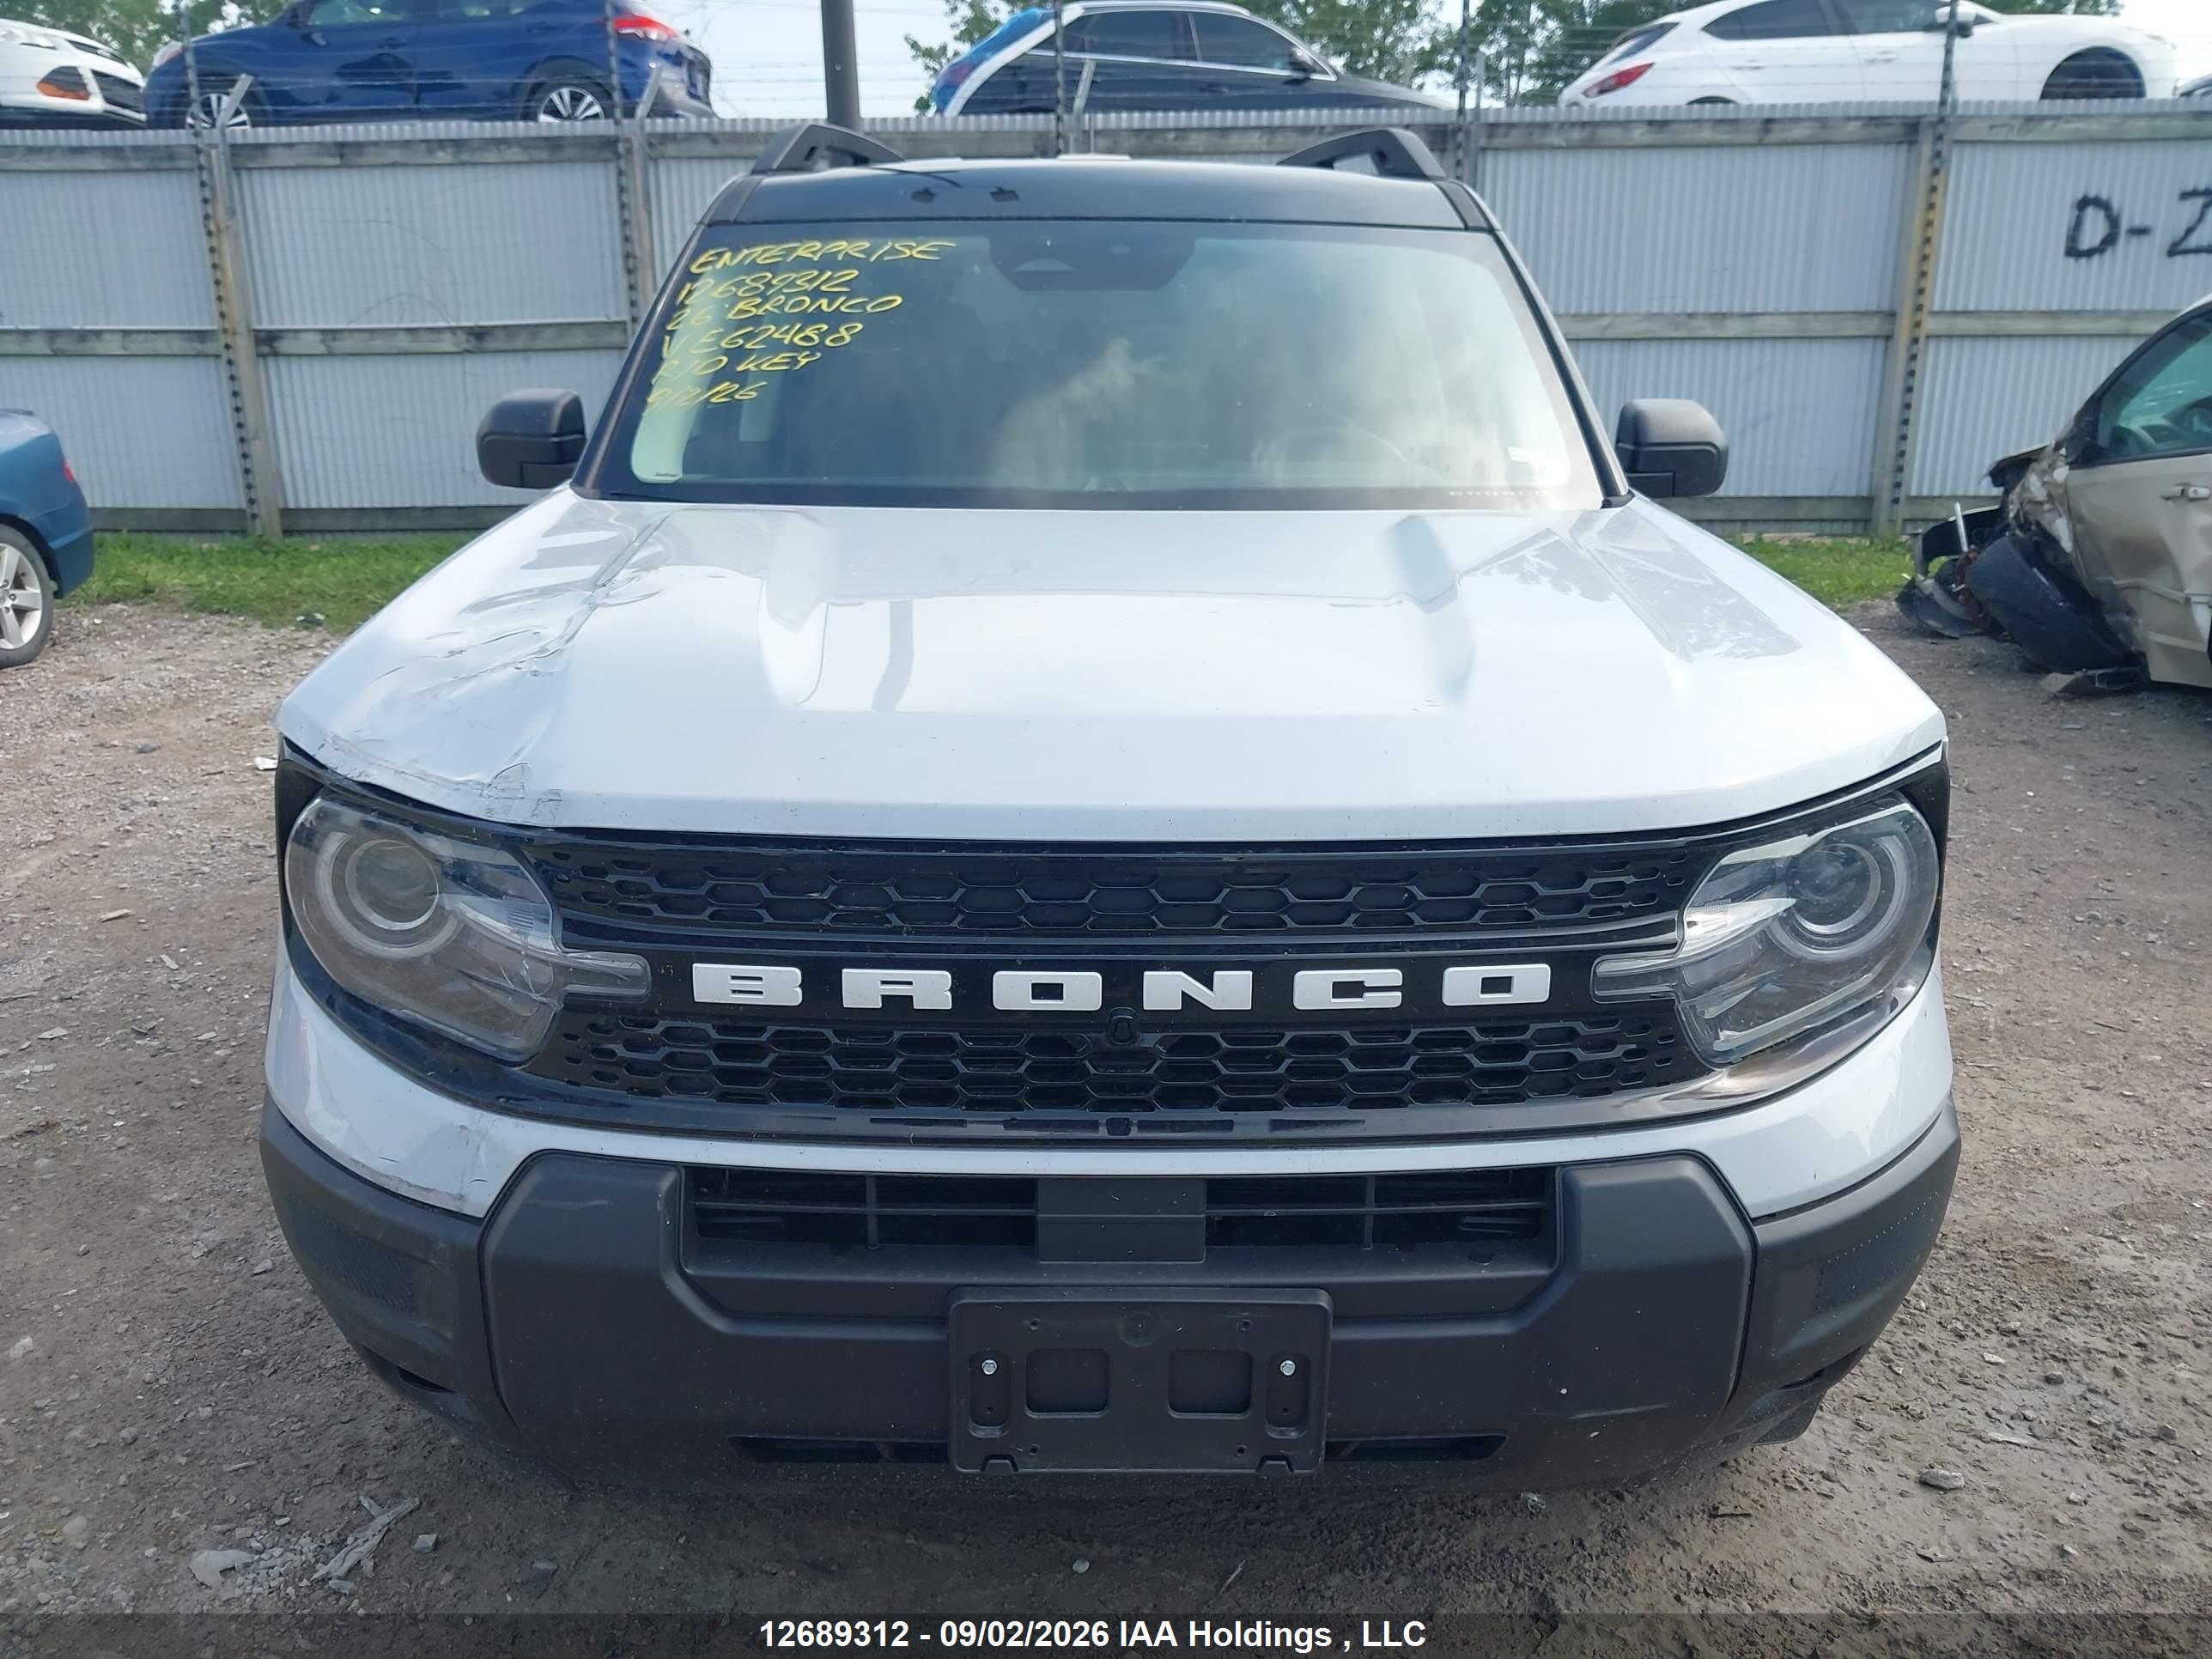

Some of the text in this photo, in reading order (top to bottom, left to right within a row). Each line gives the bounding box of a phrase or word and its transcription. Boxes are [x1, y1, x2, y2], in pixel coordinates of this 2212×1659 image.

[690, 240, 956, 274] ENTERPRISE
[676, 270, 860, 304] 12689312
[666, 295, 902, 331] 26 BRONCO
[736, 350, 823, 371] KEY
[692, 963, 1552, 1011] BRONCO
